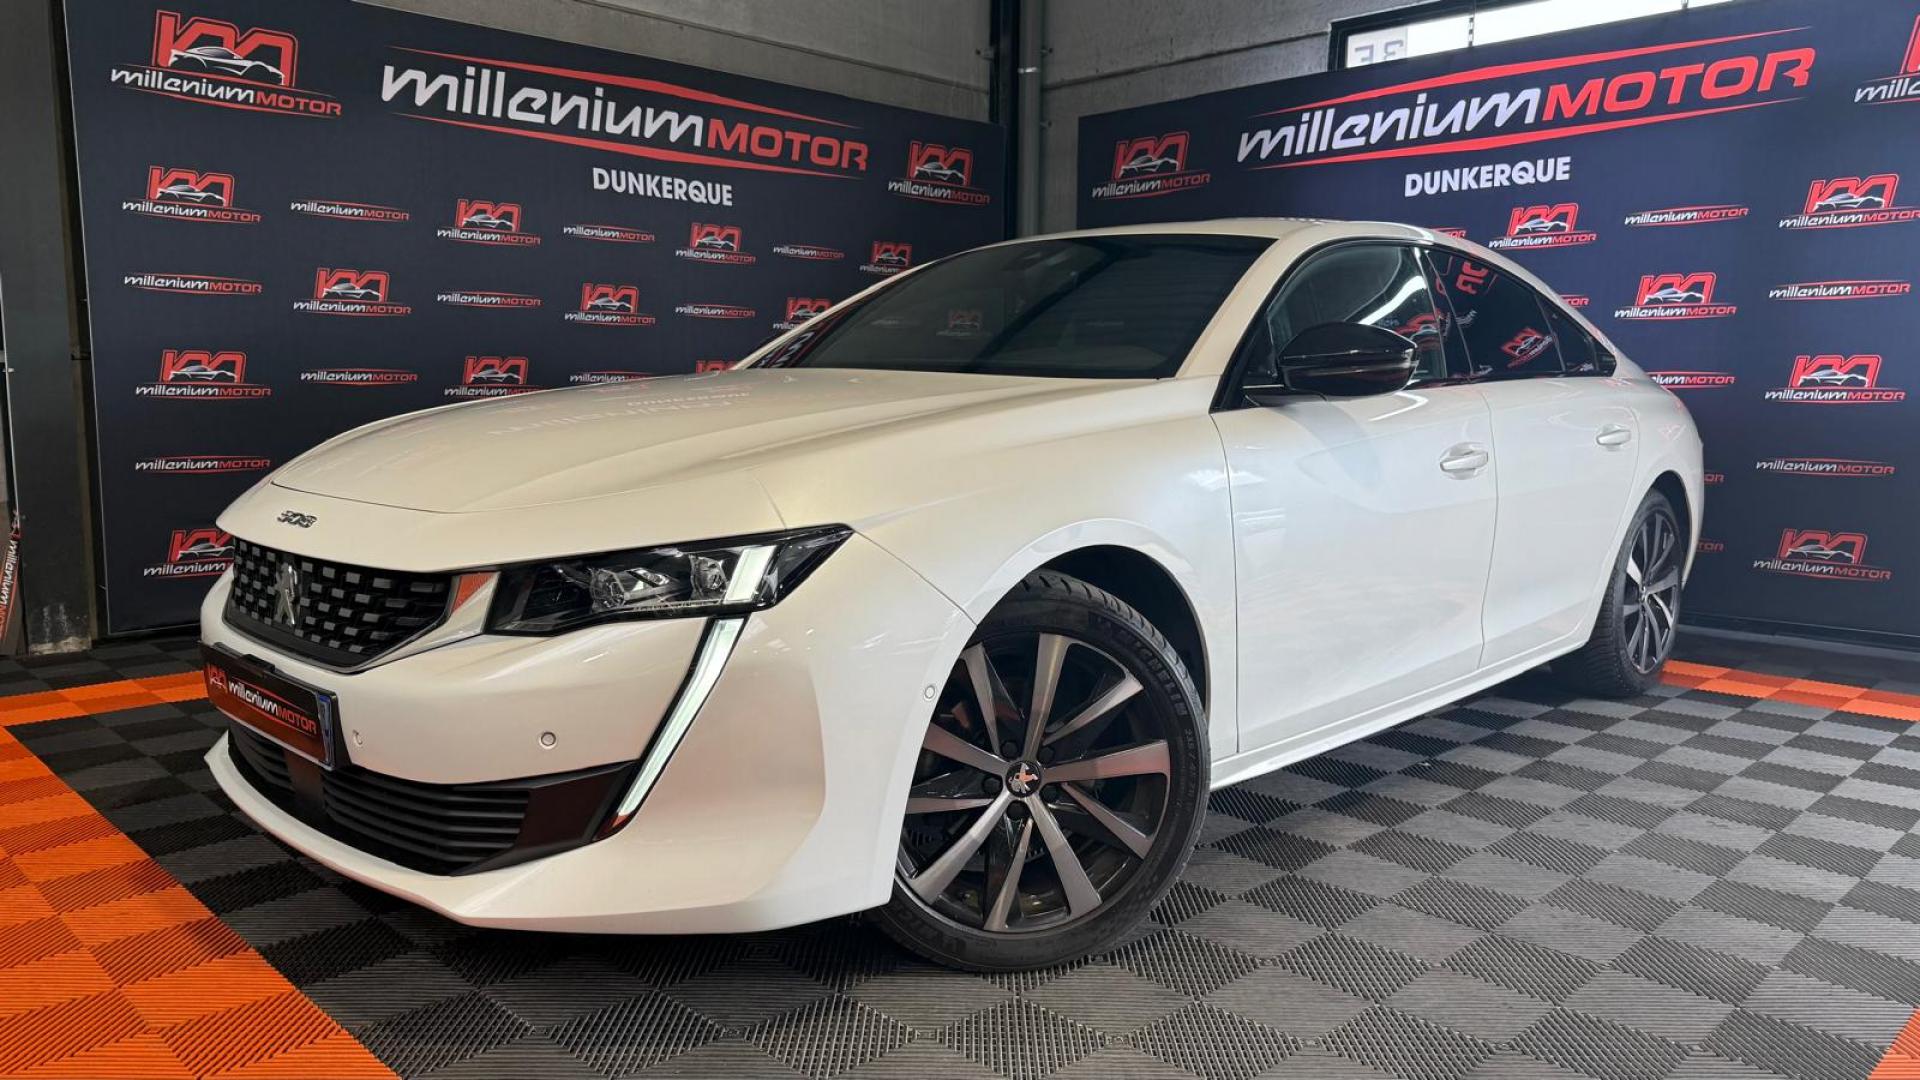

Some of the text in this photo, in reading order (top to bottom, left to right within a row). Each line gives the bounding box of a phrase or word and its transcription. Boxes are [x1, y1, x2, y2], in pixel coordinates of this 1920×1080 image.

[111, 67, 342, 116] milleniumMOTOR
[1092, 173, 1211, 198] milleniumMOTOR
[1404, 156, 1571, 198] DUNKERQUE
[592, 168, 733, 206] DUNKERQUE
[122, 201, 261, 223] milleniumMOTOR
[290, 201, 410, 221] milleniumMOTOR
[1624, 208, 1749, 225] milleniumMOTOR
[124, 275, 262, 293] milleniumMOTOR
[1769, 282, 1911, 299] milleniumMOTOR
[293, 300, 411, 315] milleniumMOTOR
[1614, 306, 1737, 318] milleniumMOTOR
[301, 371, 418, 383] milleniumMOTOR
[135, 384, 272, 397] milleniumMOTOR
[1765, 388, 1906, 402] milleniumMOTOR
[135, 458, 270, 470] milleniumMOTOR
[1757, 459, 1895, 475] milleniumMOTOR
[1753, 559, 1892, 580] milleniumMOTOR
